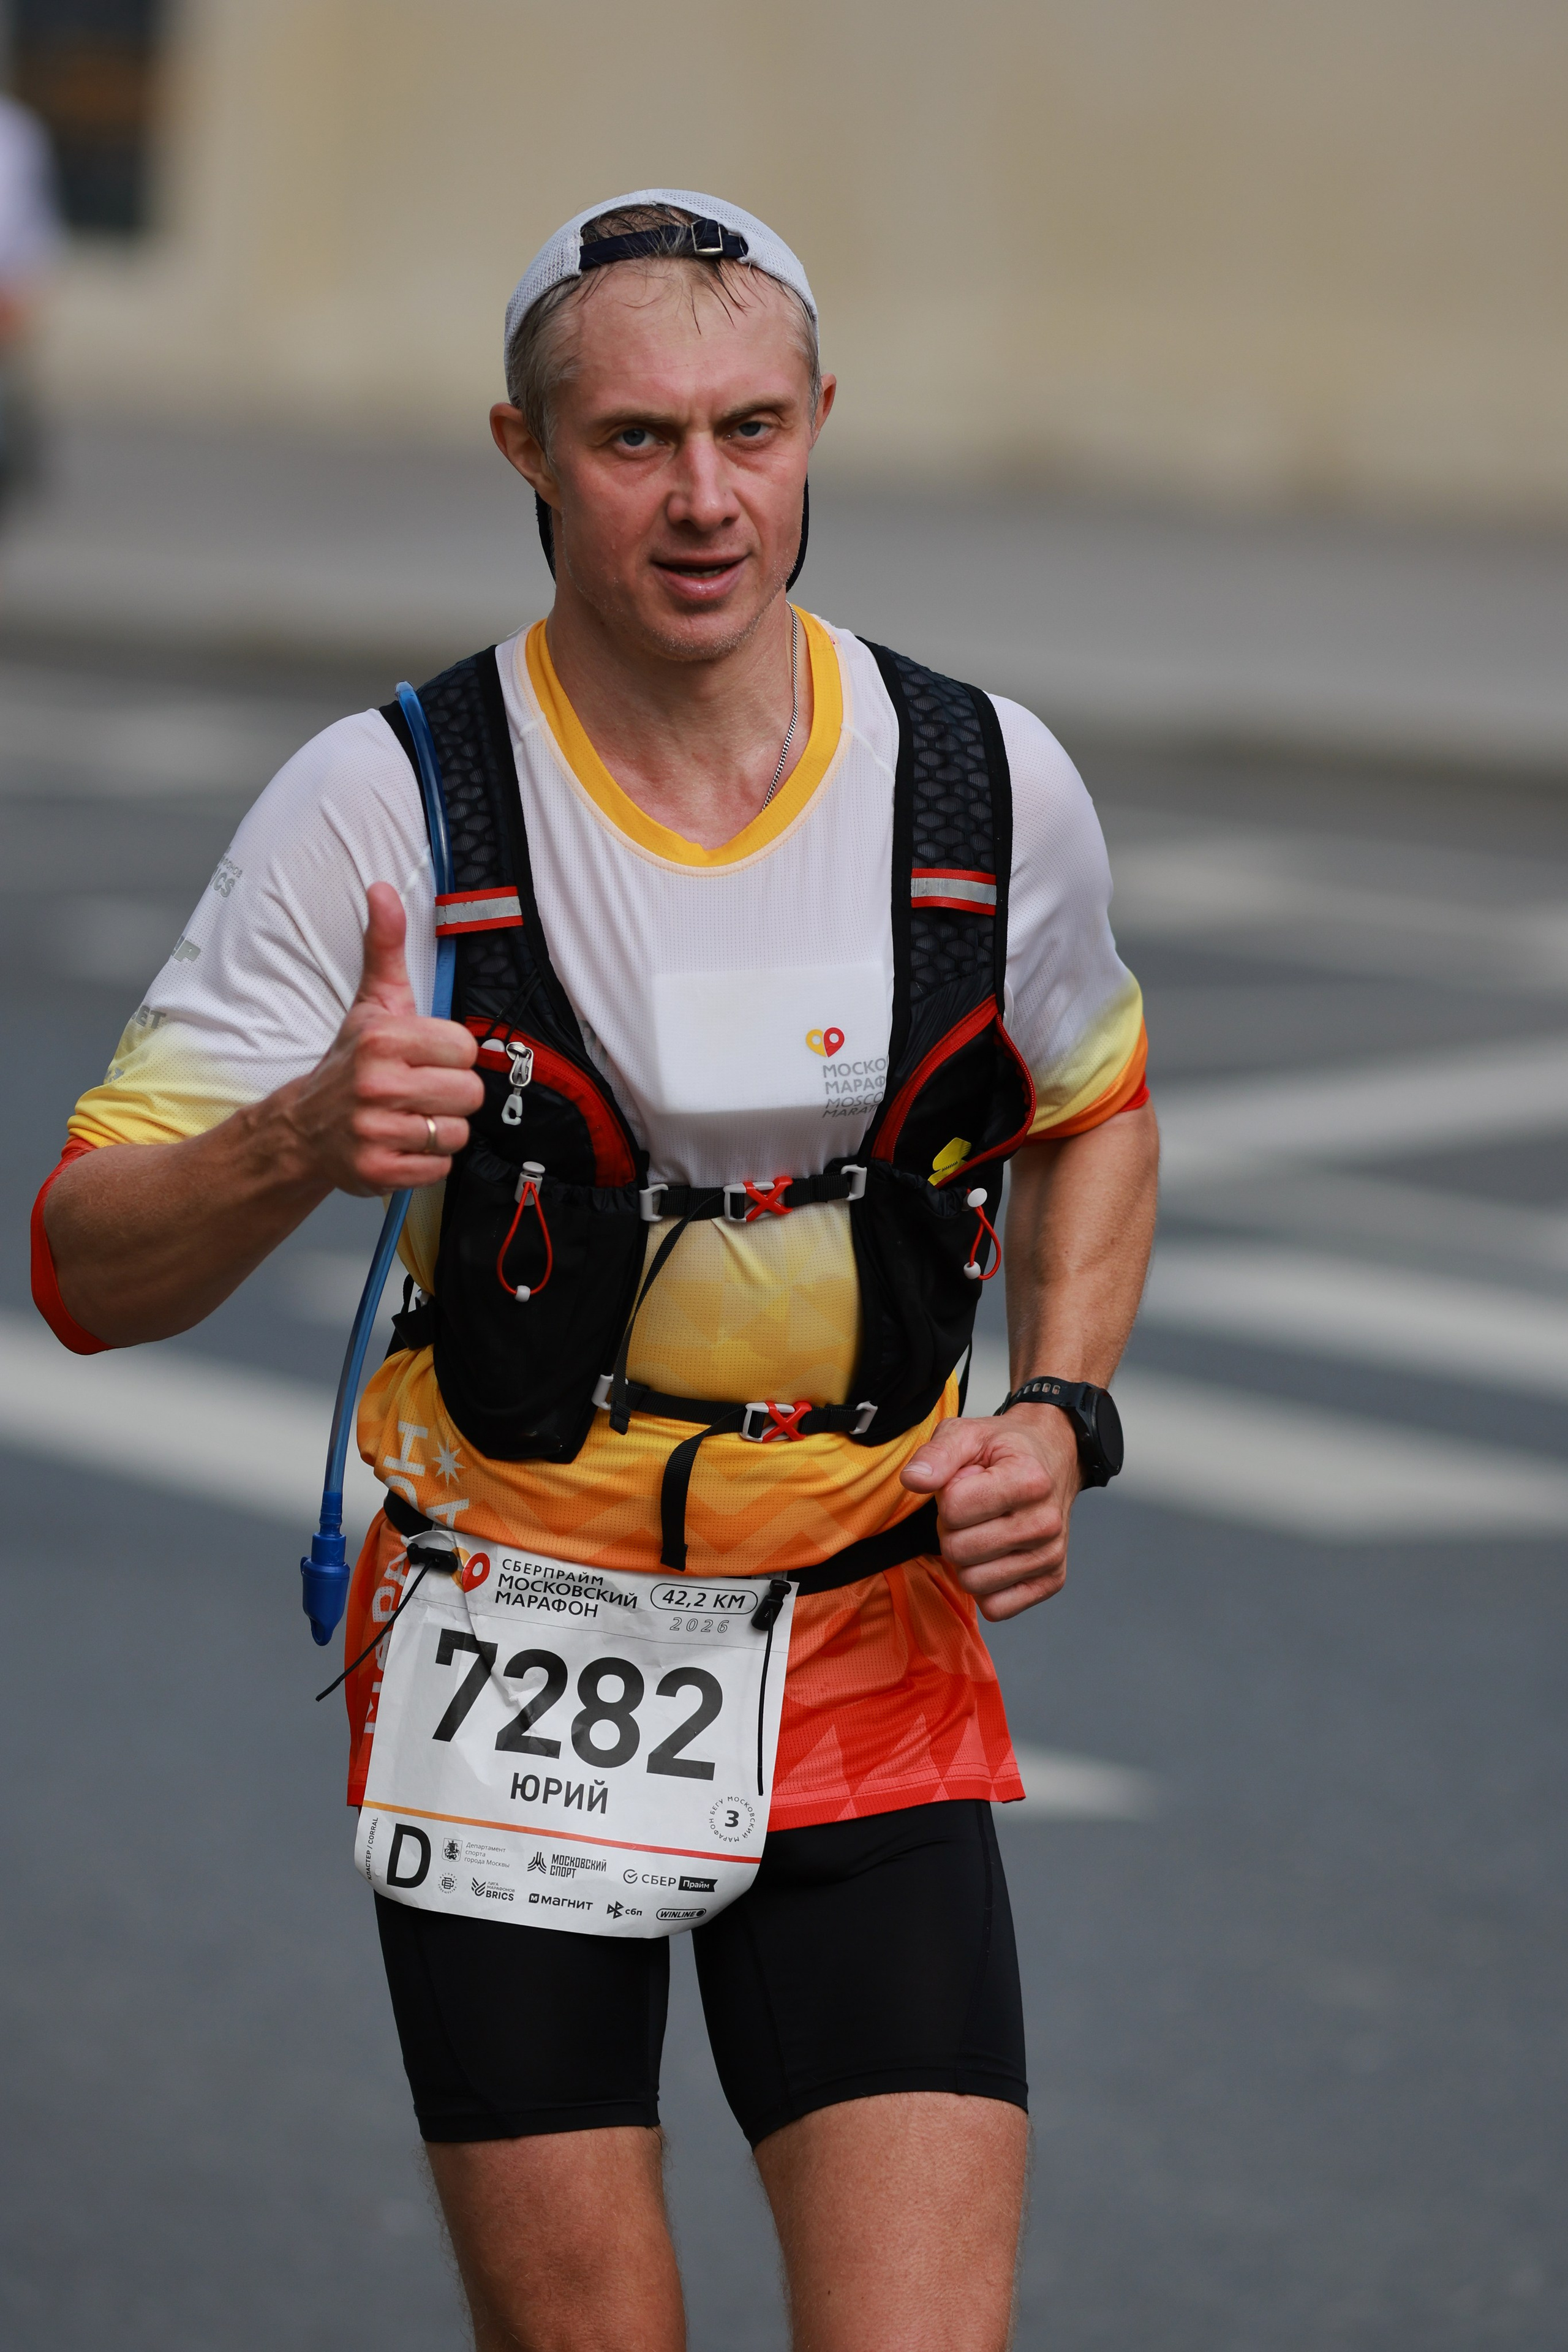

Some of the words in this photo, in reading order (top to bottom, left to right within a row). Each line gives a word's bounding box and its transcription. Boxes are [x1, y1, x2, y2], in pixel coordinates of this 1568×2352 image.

[823, 1055, 889, 1078] МОСКО
[825, 1091, 884, 1109] MOSCO
[502, 1559, 603, 1585] СБЕРПРАЙМ
[498, 1574, 638, 1608] МОСКОВСКИЙ
[663, 1590, 706, 1608] 42,2
[495, 1591, 598, 1617] МАРАФОН
[669, 1617, 729, 1633] 2026
[432, 1628, 723, 1781] 7282
[510, 1773, 608, 1814] ЮРИЙ
[709, 1799, 723, 1815] БЕГУ
[725, 1809, 739, 1828] 3
[727, 1796, 755, 1838] МОСКОВСКИЙ
[368, 1817, 379, 1844] CORRAL
[709, 1818, 739, 1842] МАРАФОН
[386, 1823, 431, 1888] D
[466, 1842, 506, 1852] Департамент
[486, 1860, 510, 1868] Москвы
[550, 1865, 576, 1879] СПОРТ
[551, 1854, 607, 1872] МОСКОВСКИЙ
[641, 1874, 676, 1887] СБЕР
[682, 1880, 710, 1889] Прайм
[486, 1890, 514, 1901] BRICS
